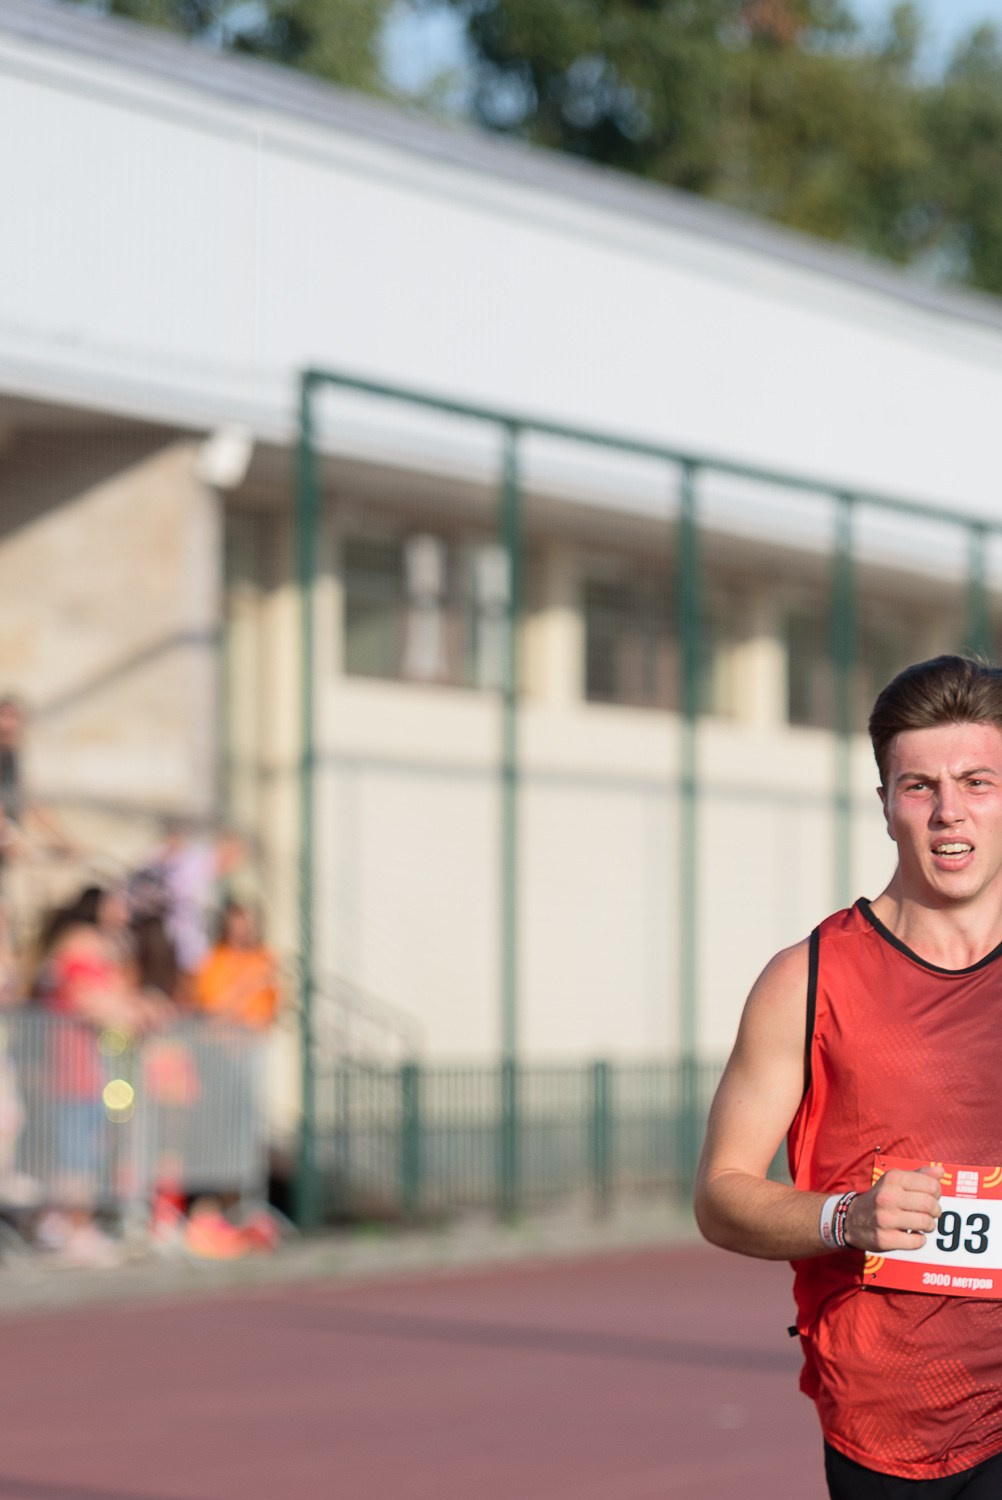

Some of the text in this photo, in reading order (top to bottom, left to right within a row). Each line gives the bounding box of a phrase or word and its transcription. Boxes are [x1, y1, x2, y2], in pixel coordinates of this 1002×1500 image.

[936, 1211, 990, 1254] 93
[922, 1272, 993, 1291] 3000 метров
